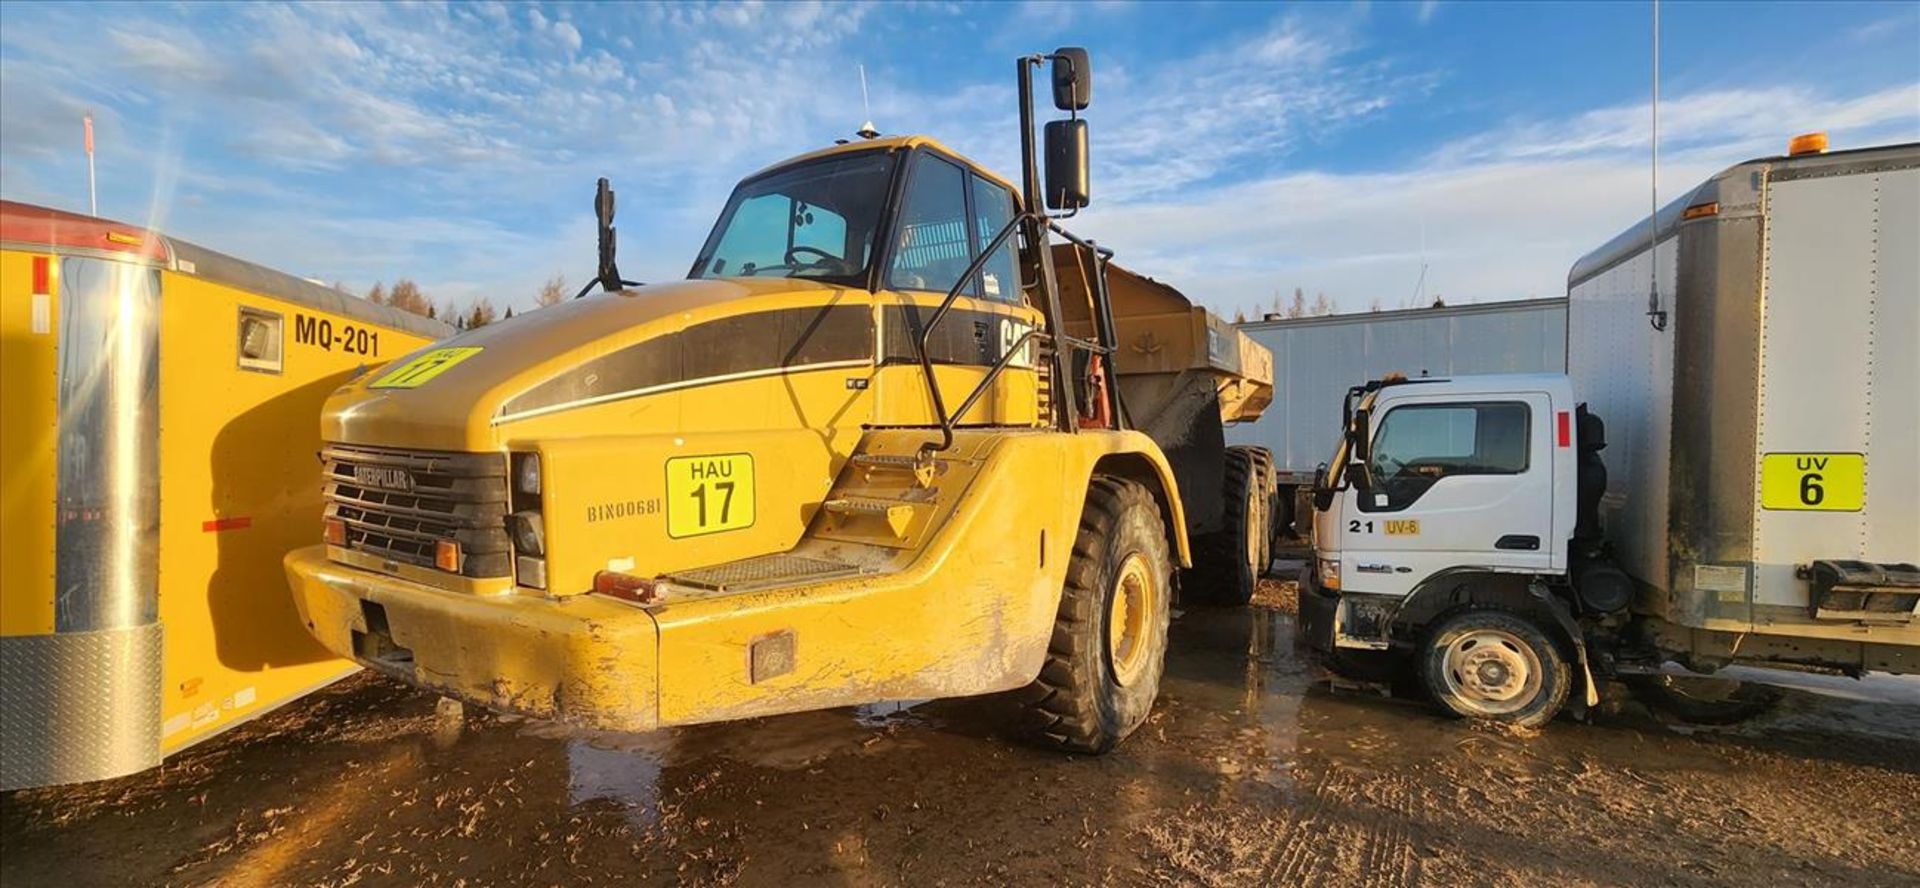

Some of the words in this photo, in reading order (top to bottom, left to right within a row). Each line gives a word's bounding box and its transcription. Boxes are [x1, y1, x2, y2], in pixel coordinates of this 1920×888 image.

[295, 314, 377, 357] MQ-201
[691, 459, 732, 480] HAU
[1796, 457, 1829, 471] UV
[1800, 473, 1825, 506] 6
[690, 481, 735, 528] 17
[1349, 519, 1374, 534] 21
[1386, 520, 1417, 534] UV-6
